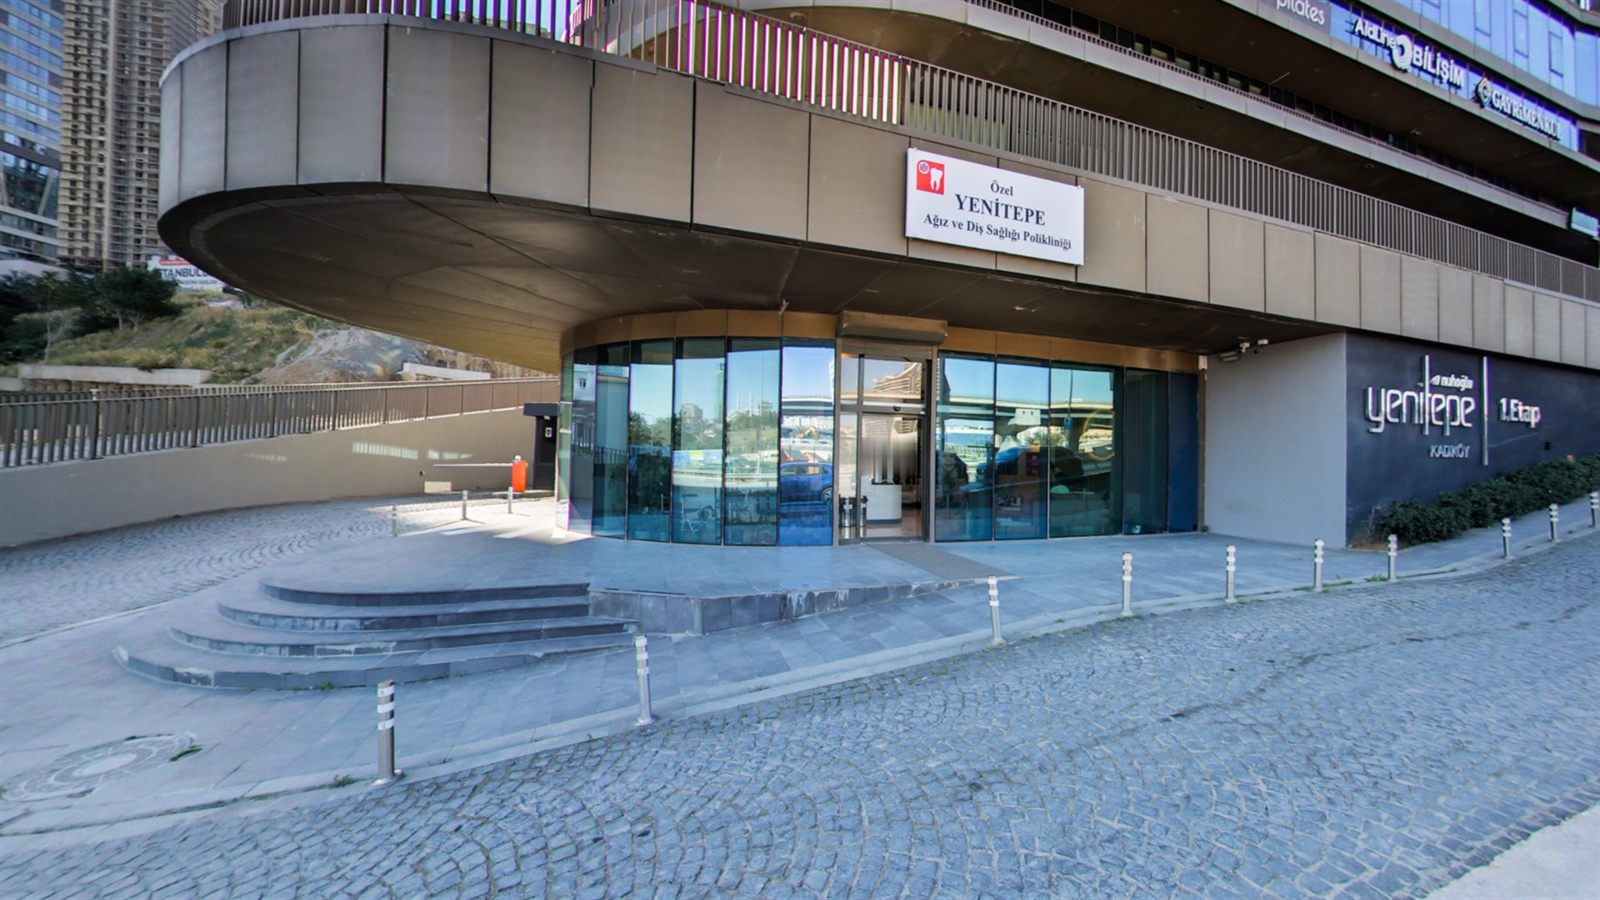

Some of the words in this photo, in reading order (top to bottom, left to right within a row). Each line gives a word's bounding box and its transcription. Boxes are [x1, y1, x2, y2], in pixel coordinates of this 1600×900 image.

[1412, 43, 1464, 87] BİLİŞİM
[990, 179, 1014, 196] Özel
[955, 193, 1046, 226] YENİTEPE
[923, 213, 949, 229] Ağız
[952, 221, 964, 230] ve
[967, 221, 984, 236] Diş
[986, 224, 1021, 241] Sağlığı
[1023, 230, 1072, 250] Polikliniği
[1367, 355, 1475, 436] yenitepe
[1499, 397, 1541, 429] 1.Etap
[1430, 443, 1470, 458] KADIKÖY
